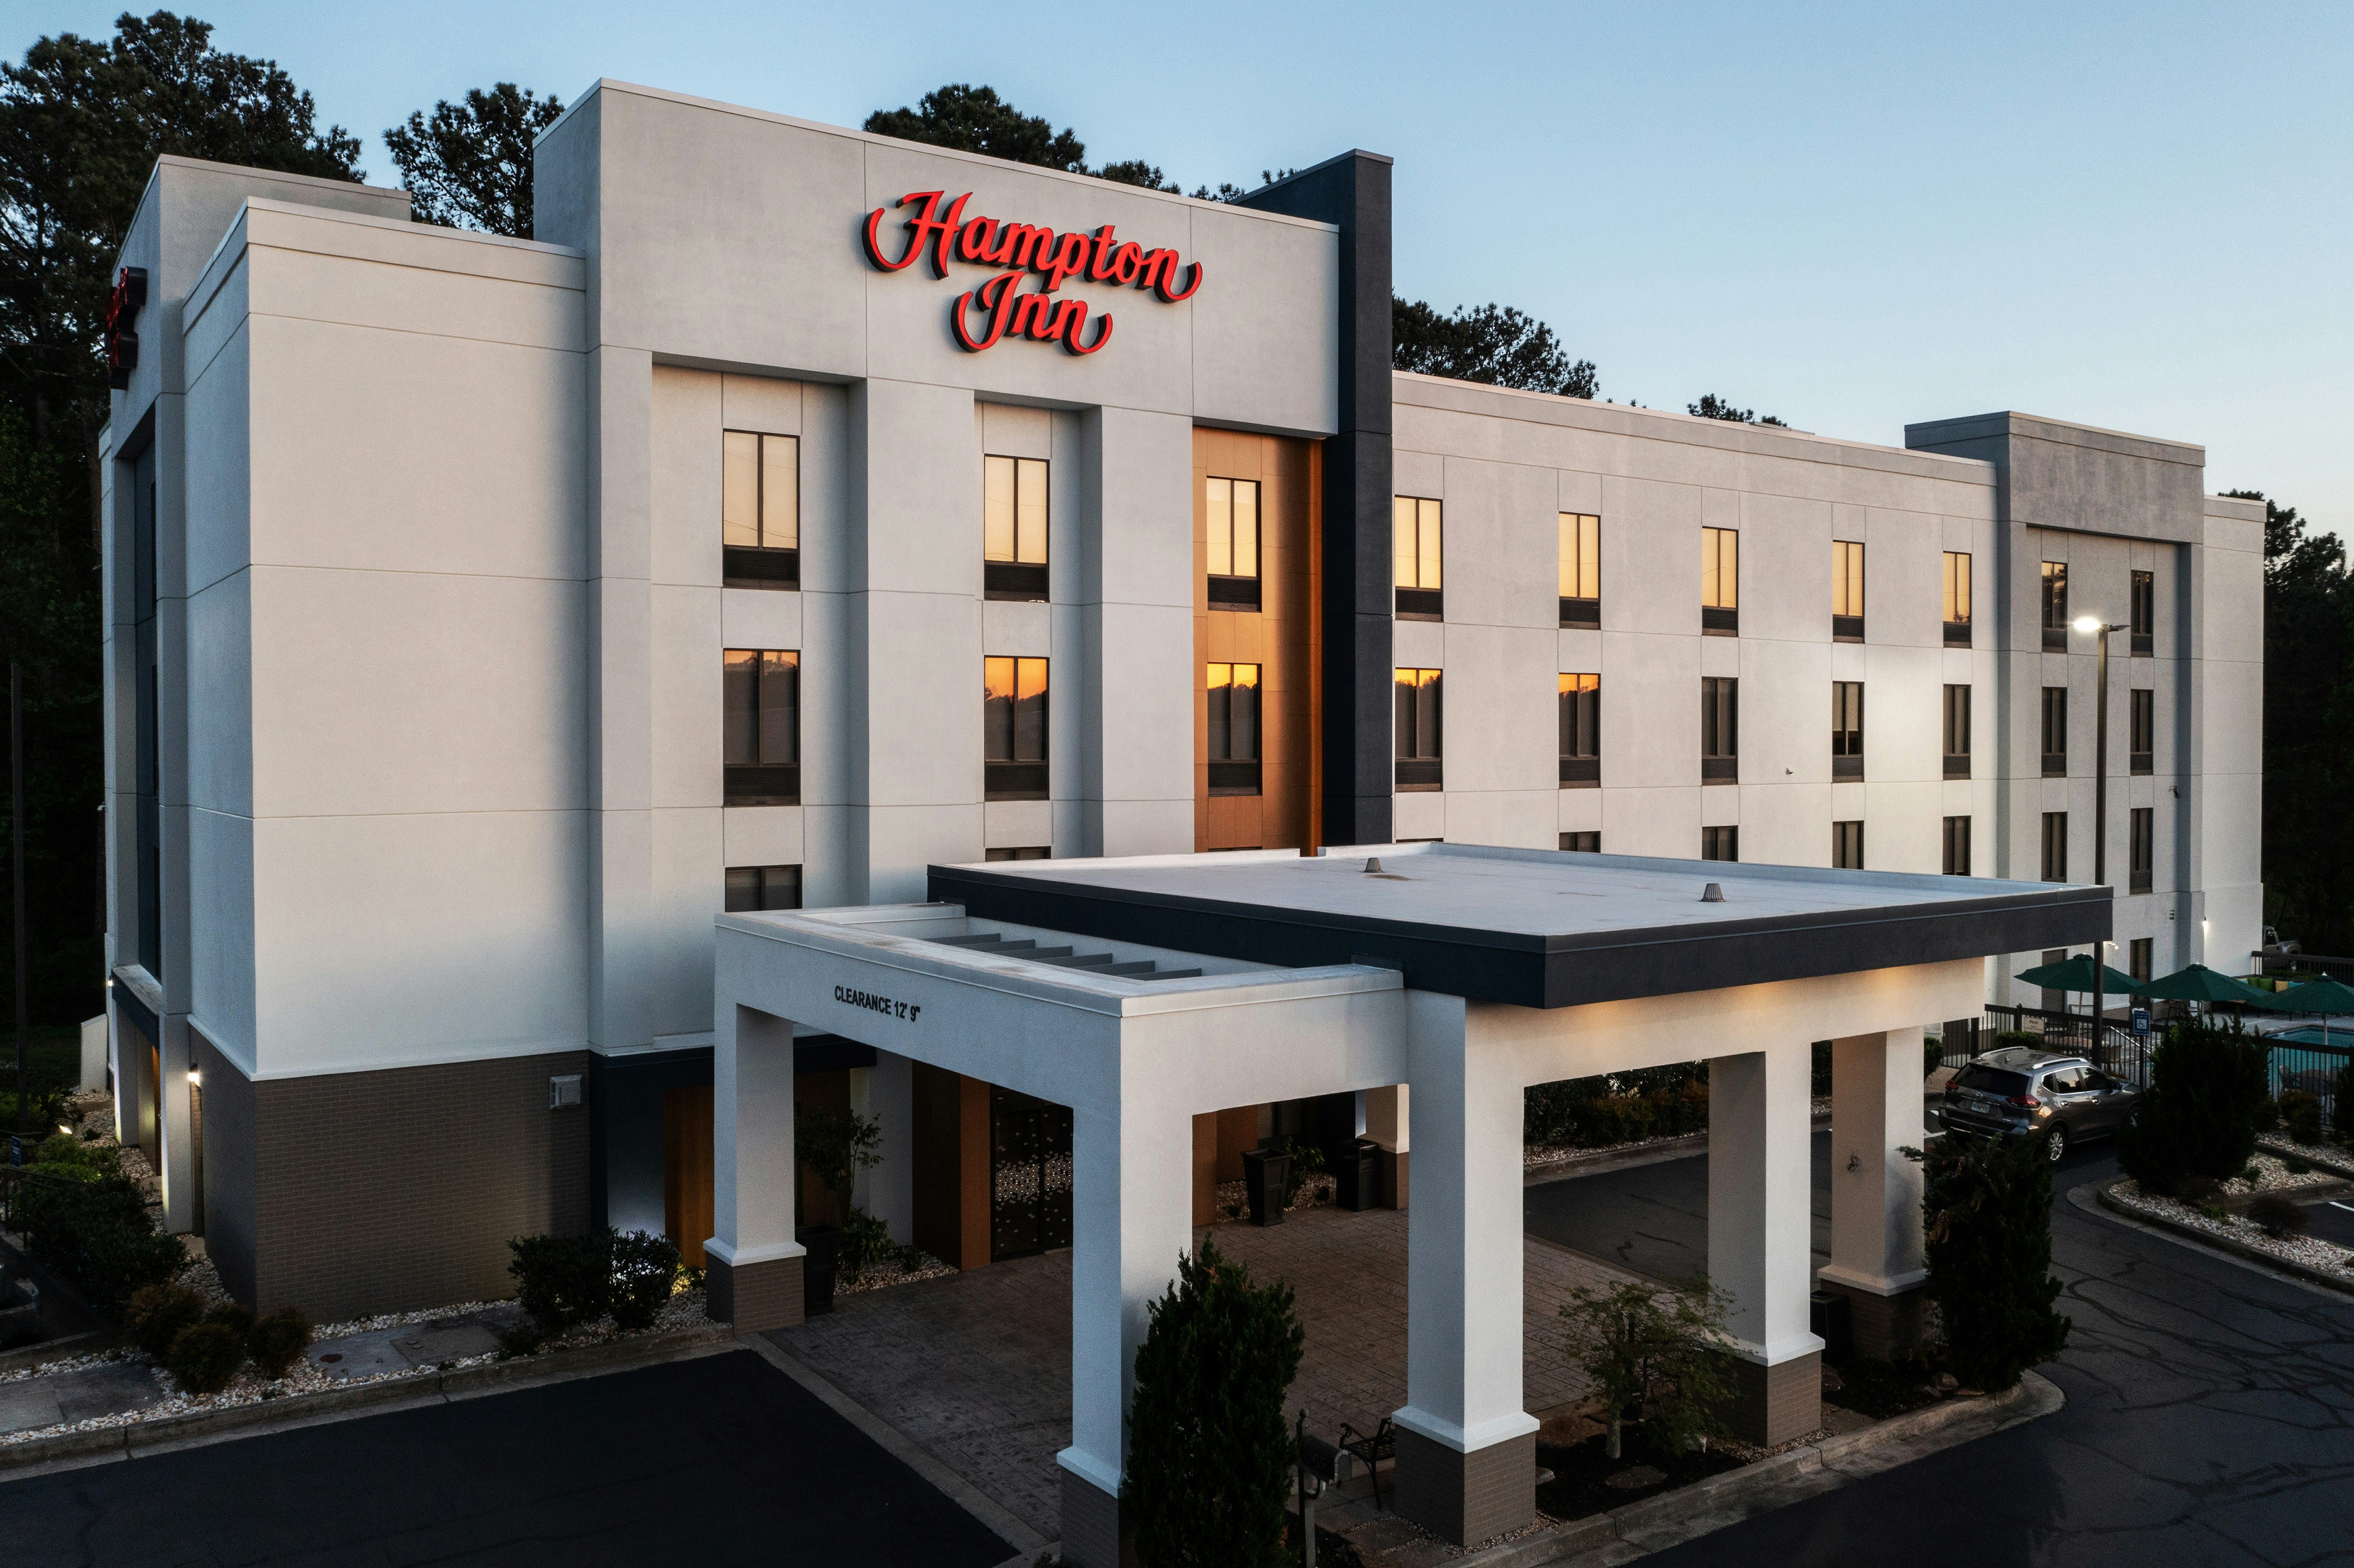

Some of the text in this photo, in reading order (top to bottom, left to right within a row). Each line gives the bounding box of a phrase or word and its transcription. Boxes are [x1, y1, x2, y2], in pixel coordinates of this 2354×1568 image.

[864, 190, 1203, 302] Hampton
[952, 271, 1113, 355] Inn
[834, 985, 891, 1015] CLEARANCE
[894, 1001, 908, 1019] 12'
[1311, 1451, 1326, 1470] 915
